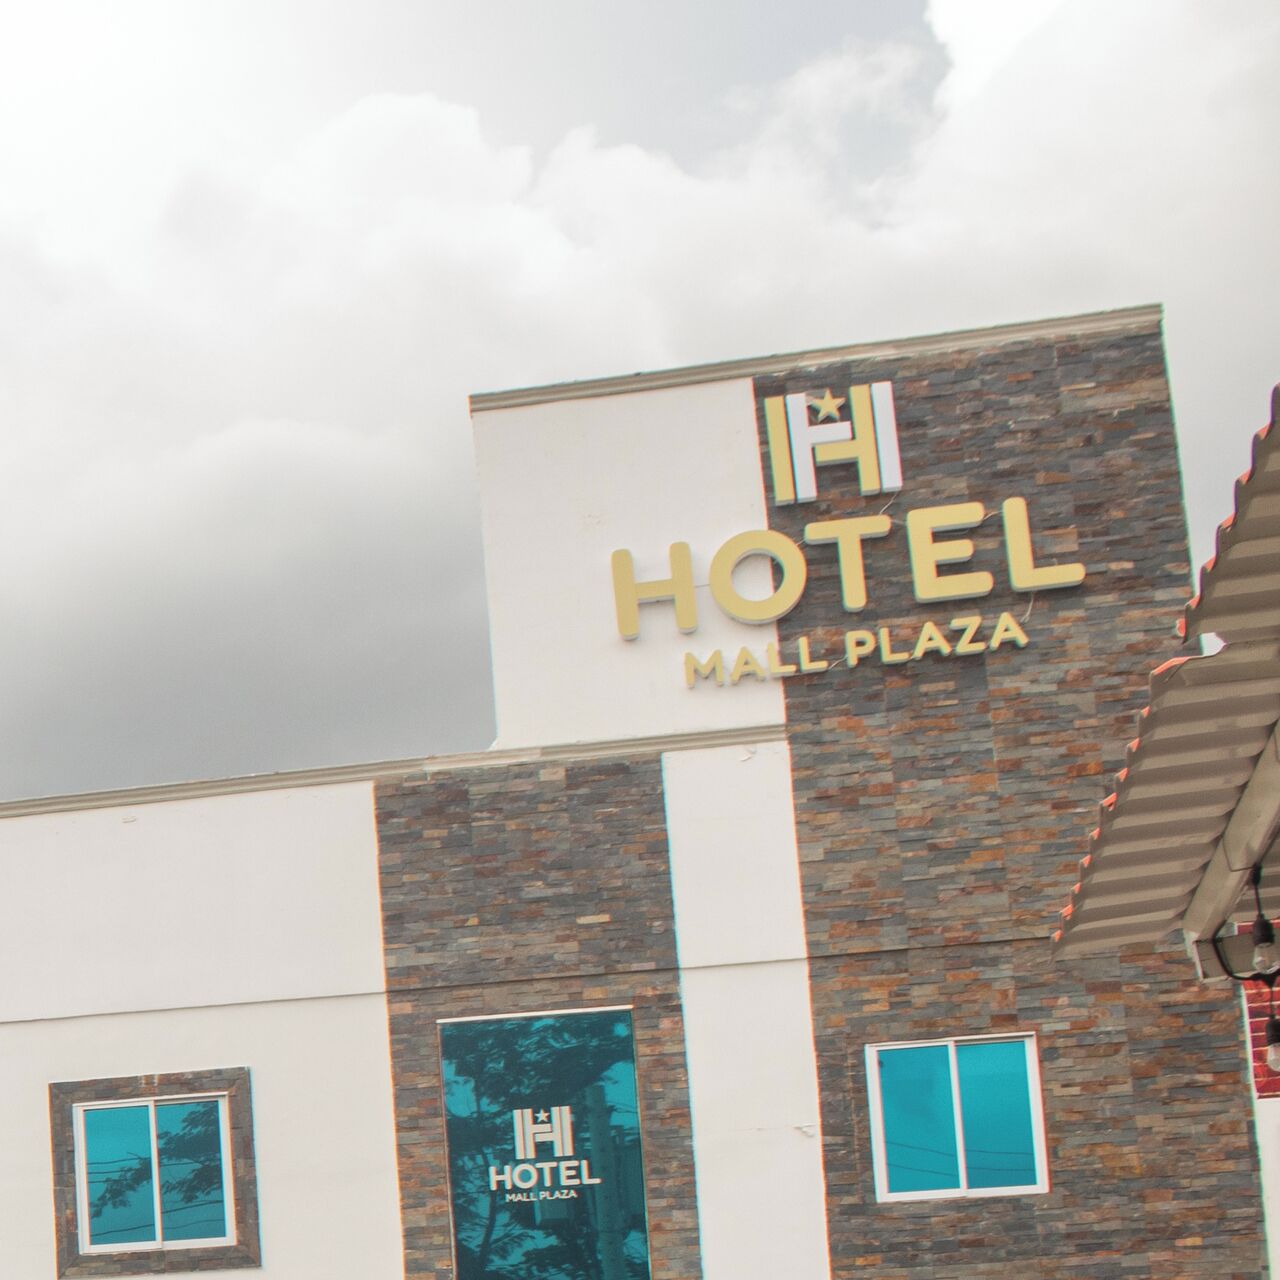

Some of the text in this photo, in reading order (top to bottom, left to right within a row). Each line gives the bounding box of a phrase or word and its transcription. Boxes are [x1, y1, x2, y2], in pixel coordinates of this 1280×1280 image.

[611, 496, 1086, 640] HOTEL
[684, 611, 1029, 688] MALL PLAZA
[488, 1160, 602, 1191] HOTEL
[505, 1190, 578, 1202] MALL PLAZA
